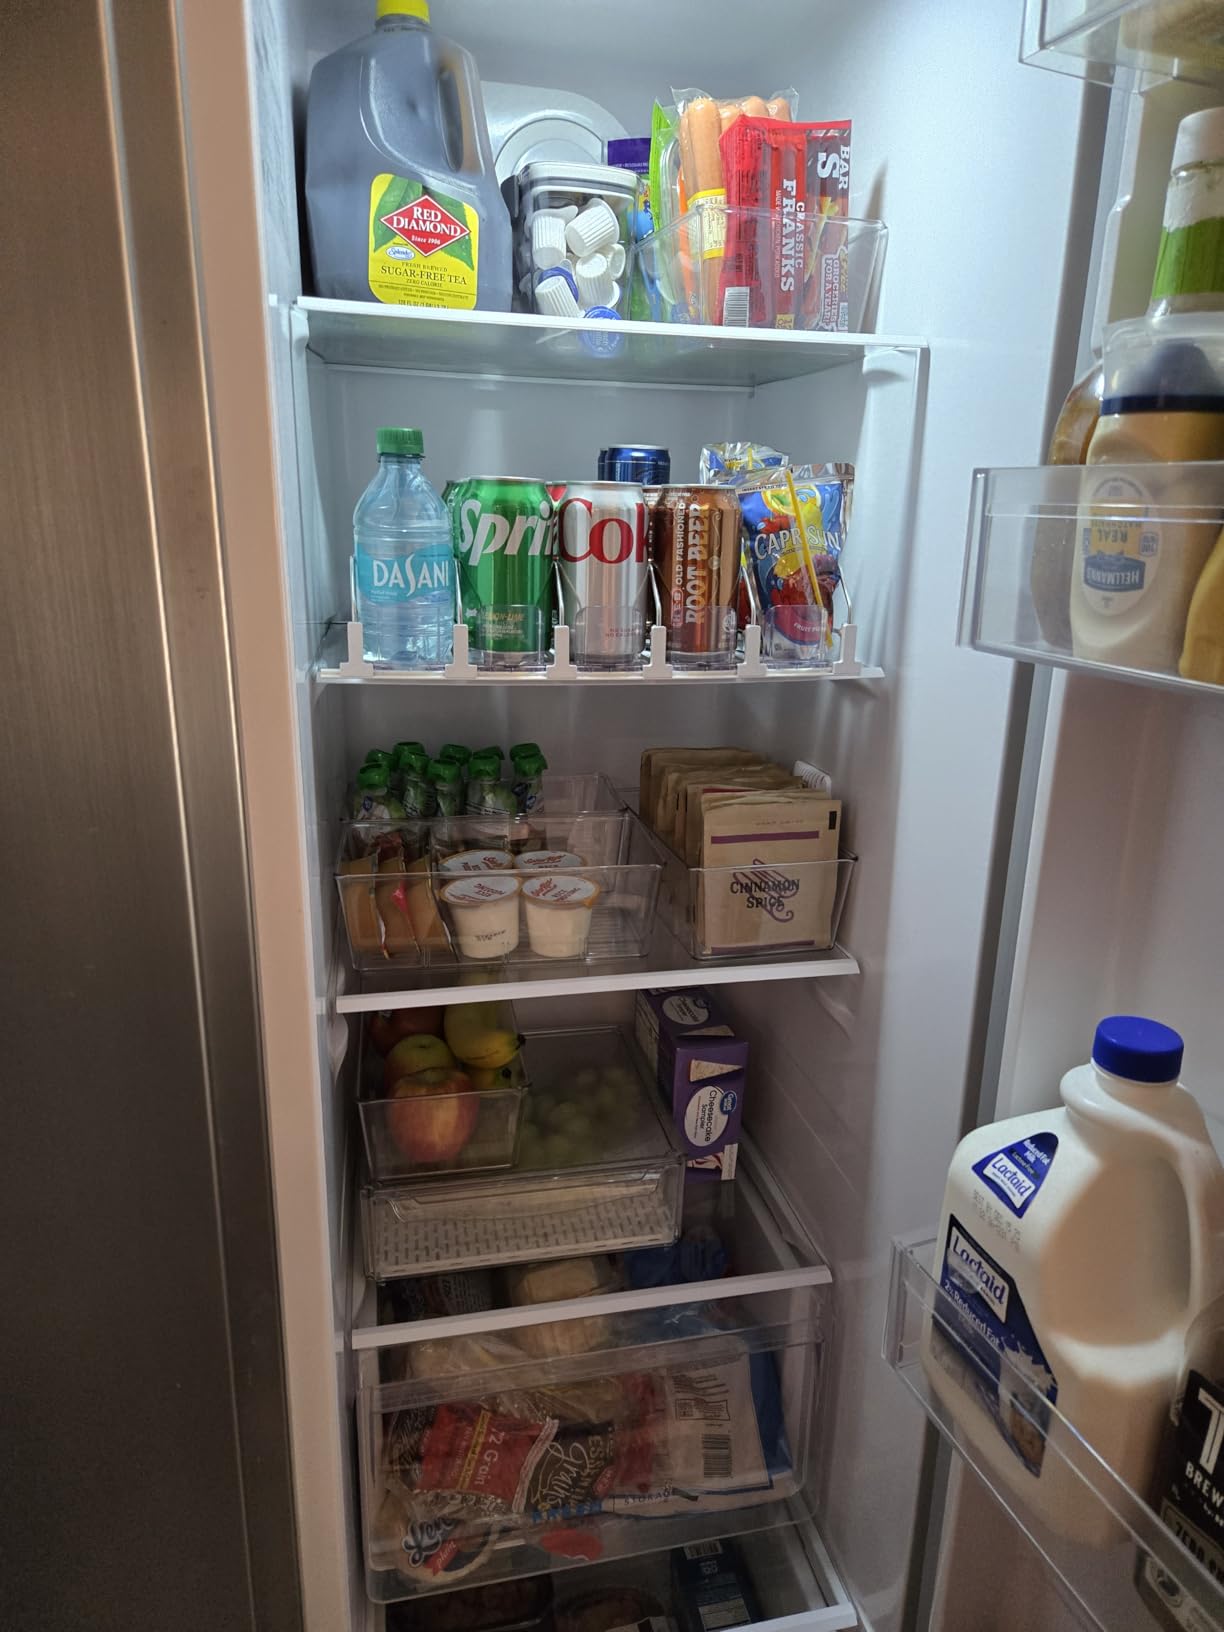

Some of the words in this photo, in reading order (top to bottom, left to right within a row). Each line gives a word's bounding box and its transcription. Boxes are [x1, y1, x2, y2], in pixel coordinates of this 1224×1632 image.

[817, 152, 840, 179] S
[838, 144, 850, 190] BAR
[393, 216, 461, 237] DIAMOND
[413, 206, 442, 222] RED
[780, 178, 796, 292] FRANKS
[795, 202, 804, 269] CLASSIC
[381, 266, 445, 281] SUGAR-FREE
[447, 274, 467, 285] TEA
[830, 259, 839, 322] GROCERIES
[823, 291, 831, 323] YEAR!
[558, 497, 648, 564] Cok
[676, 502, 686, 561] FASHIONED
[687, 503, 710, 561] BEER
[754, 527, 803, 560] CAPR
[807, 525, 841, 551] SUN
[1097, 529, 1128, 544] REAL
[373, 553, 449, 596] DASANI
[675, 565, 684, 585] OLD
[672, 590, 682, 623] H-E-B
[685, 566, 706, 624] ROOT
[730, 879, 800, 894] CINNAMON
[746, 896, 785, 909] SPICE
[699, 1104, 708, 1129] Sampler
[704, 1089, 718, 1142] Cheesecake
[991, 1157, 1032, 1197] Lactaid
[952, 1235, 1005, 1305] Lactaid
[953, 1290, 987, 1333] Reduced
[986, 1325, 1001, 1348] Fat
[474, 1449, 499, 1486] Grain
